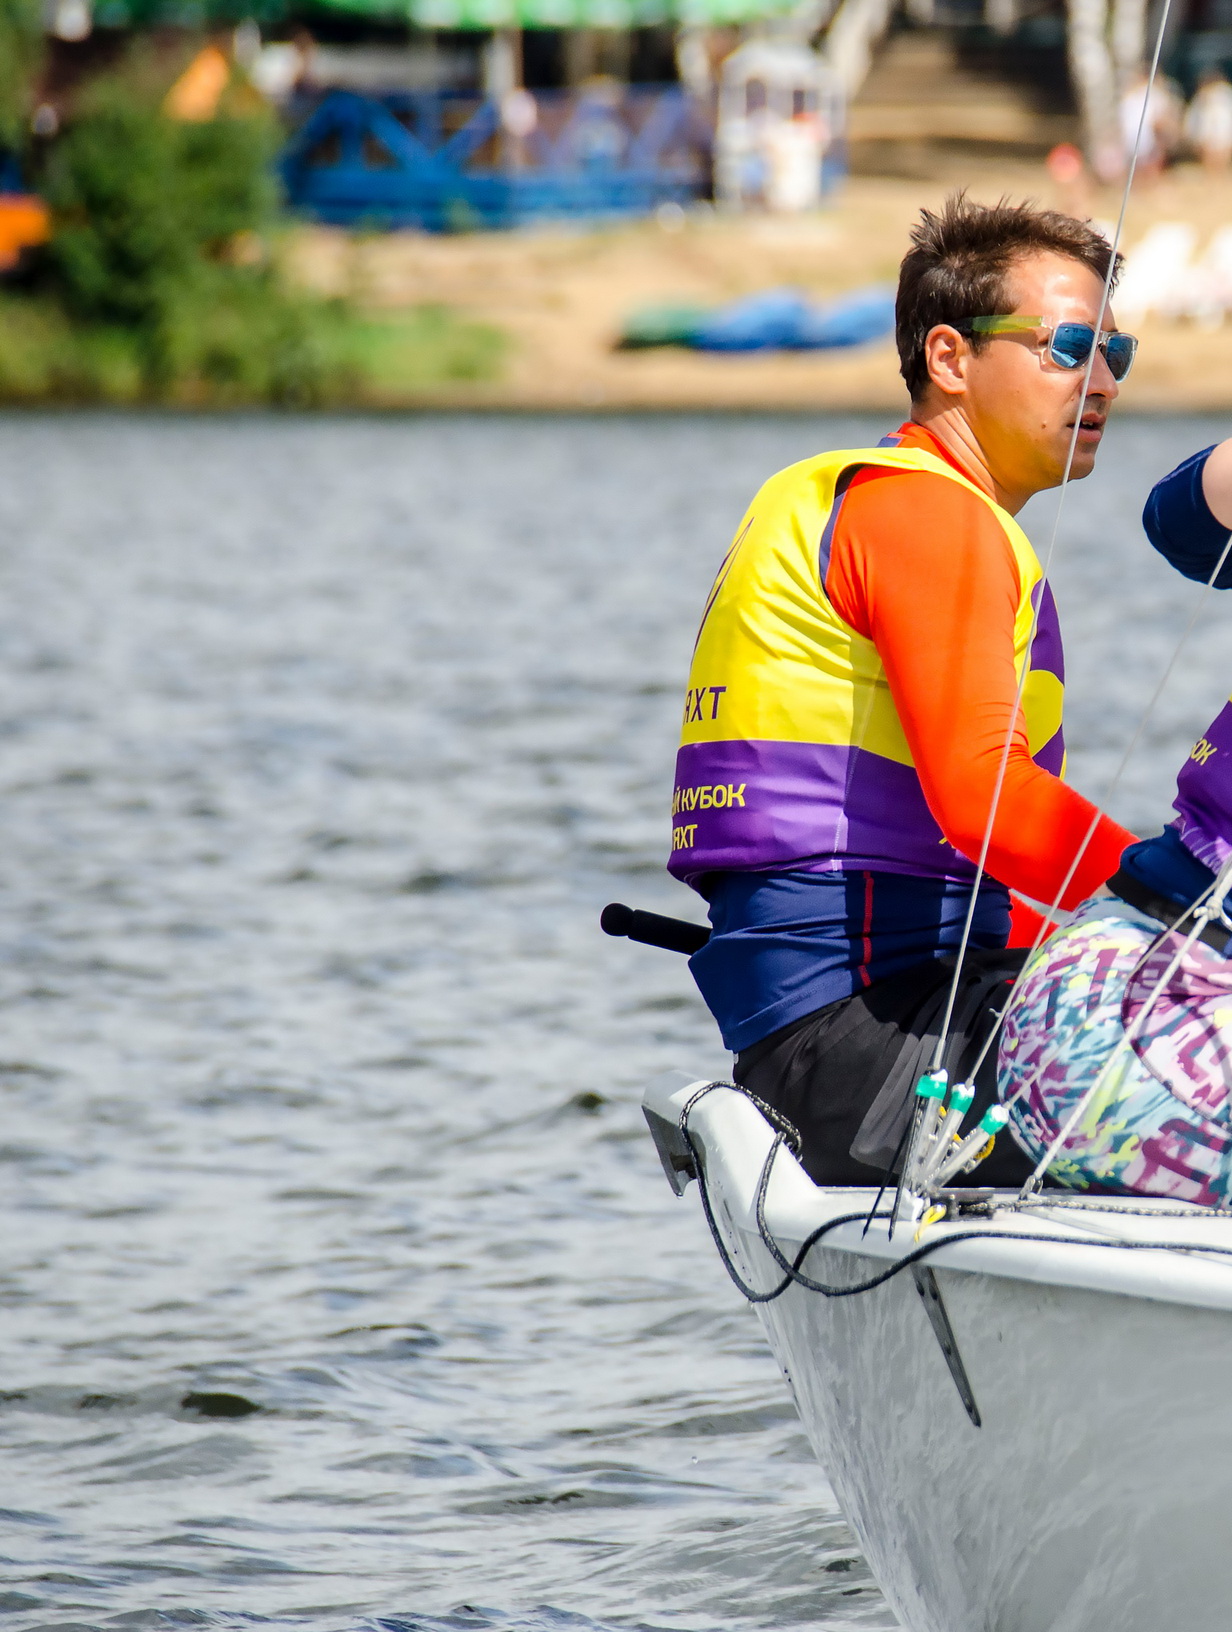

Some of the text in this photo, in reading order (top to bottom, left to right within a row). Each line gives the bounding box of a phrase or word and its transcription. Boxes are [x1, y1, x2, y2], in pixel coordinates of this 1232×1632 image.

[683, 686, 727, 725] ЯХТ
[1191, 738, 1218, 766] ОК
[681, 783, 747, 811] КУБОК
[672, 824, 698, 851] ЯХТ
